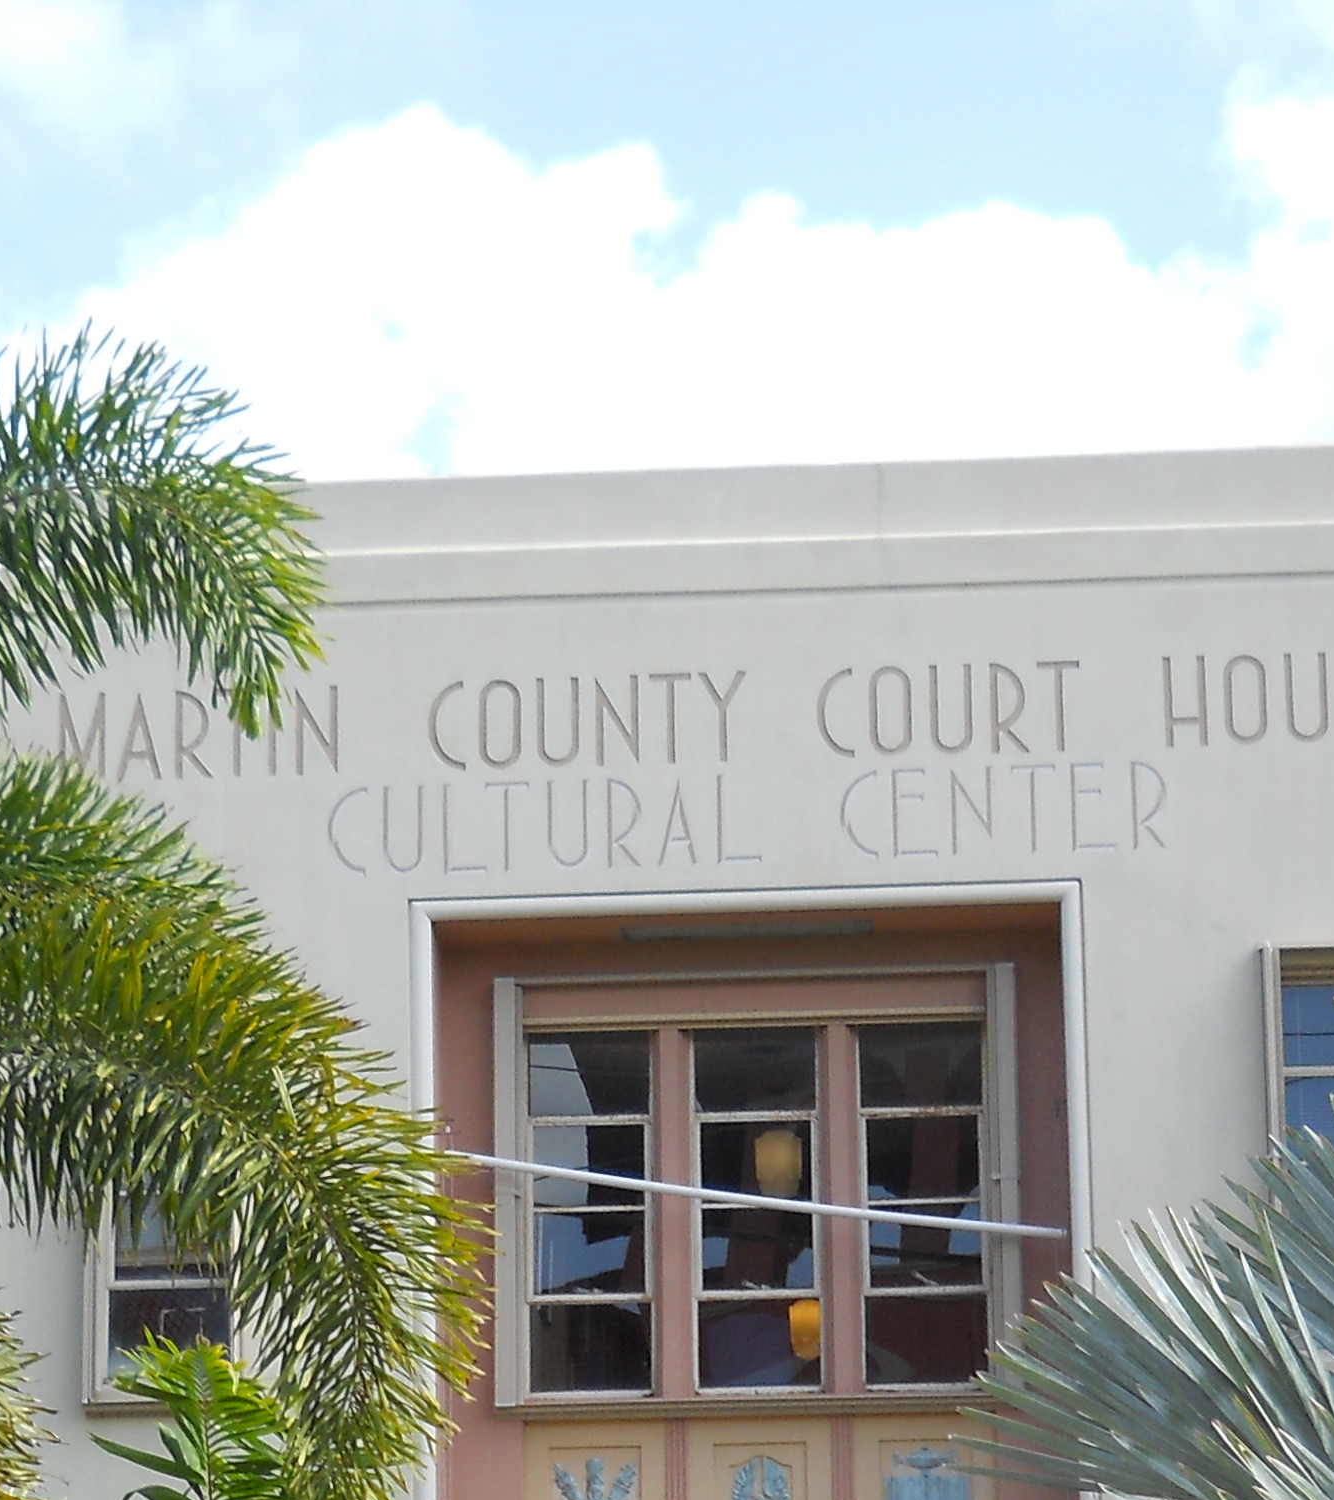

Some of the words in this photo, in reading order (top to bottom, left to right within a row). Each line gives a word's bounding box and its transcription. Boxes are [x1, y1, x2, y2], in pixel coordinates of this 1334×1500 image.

[428, 670, 747, 771] COUNTY
[816, 660, 1080, 758] COURT
[327, 774, 763, 876] CULTURAL
[840, 761, 1167, 859] CENTER
